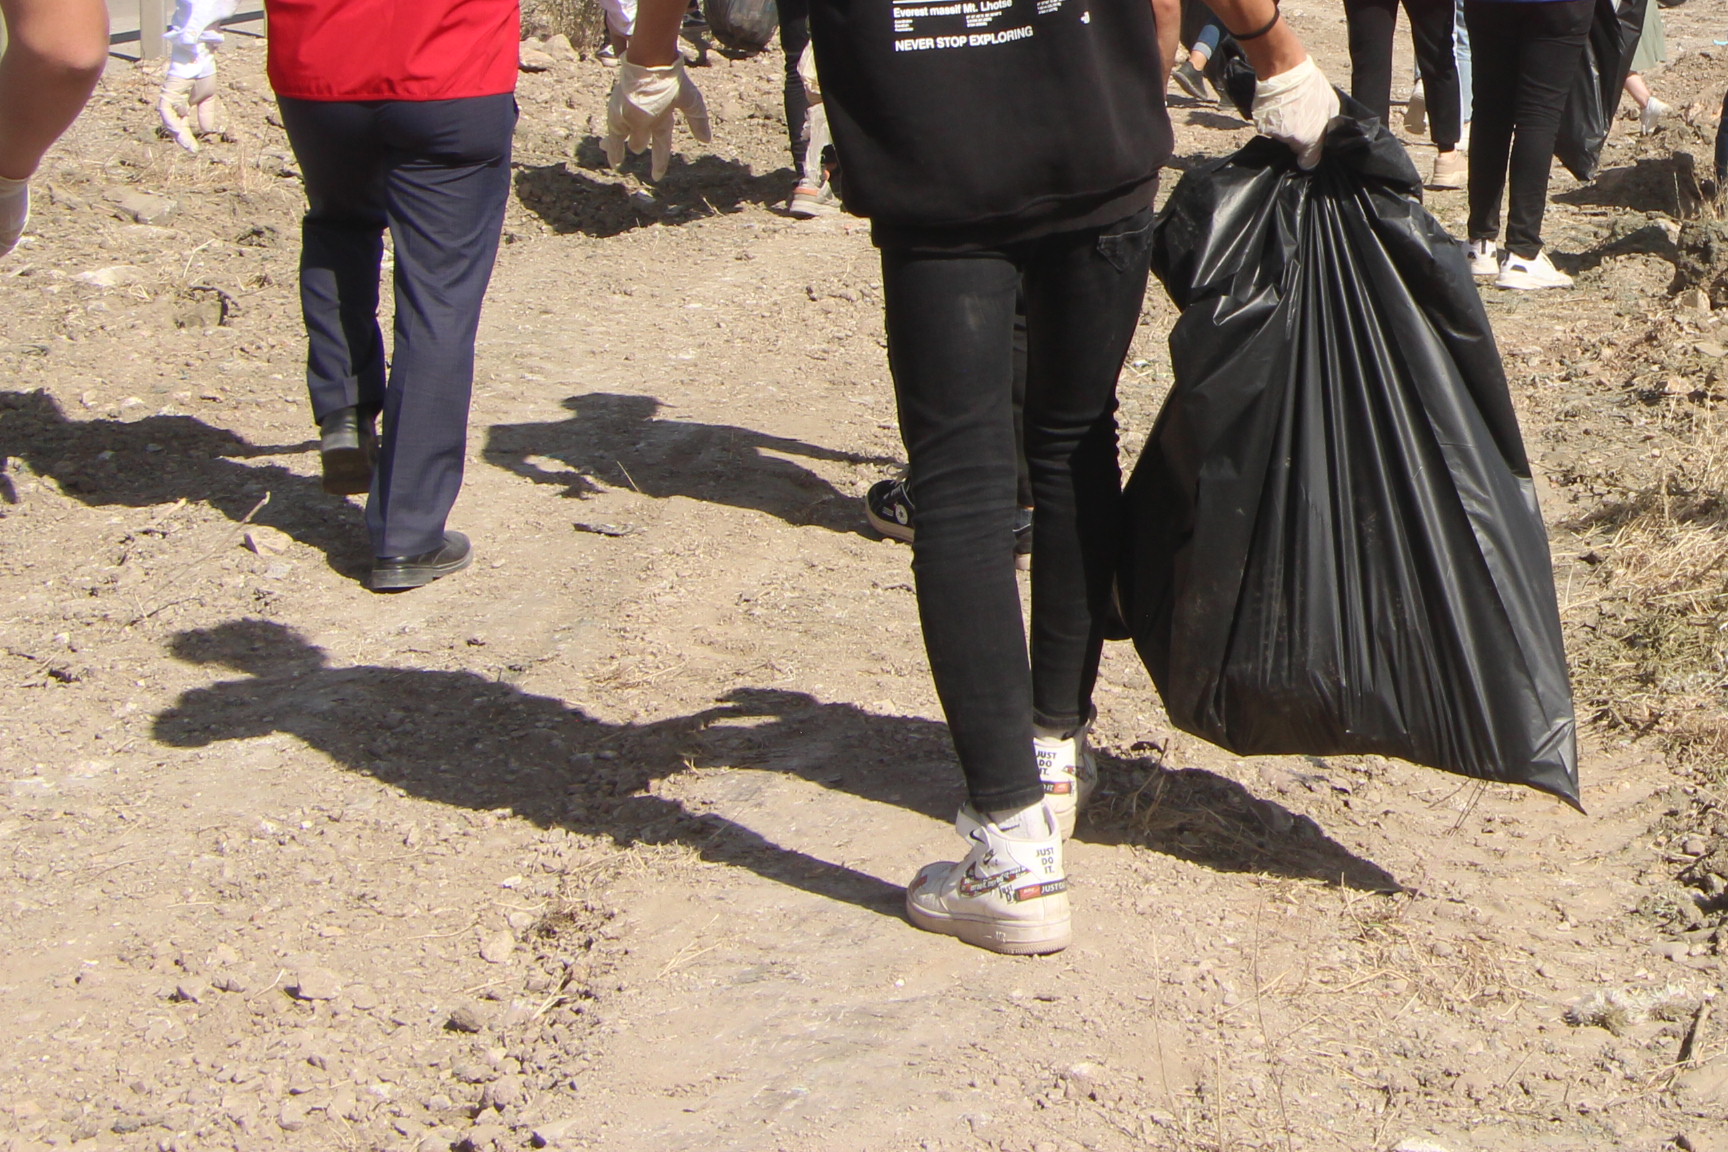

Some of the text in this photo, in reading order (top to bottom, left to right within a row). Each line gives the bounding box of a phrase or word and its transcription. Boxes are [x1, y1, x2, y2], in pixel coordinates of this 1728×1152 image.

[893, 5, 962, 19] Everest massif
[895, 25, 1034, 52] NEVER STOP EXPLORING
[1036, 750, 1057, 759] JUST
[1039, 759, 1052, 768] DO
[1036, 847, 1055, 858] JUST
[1041, 856, 1054, 866] DO
[1042, 883, 1058, 894] JUST
